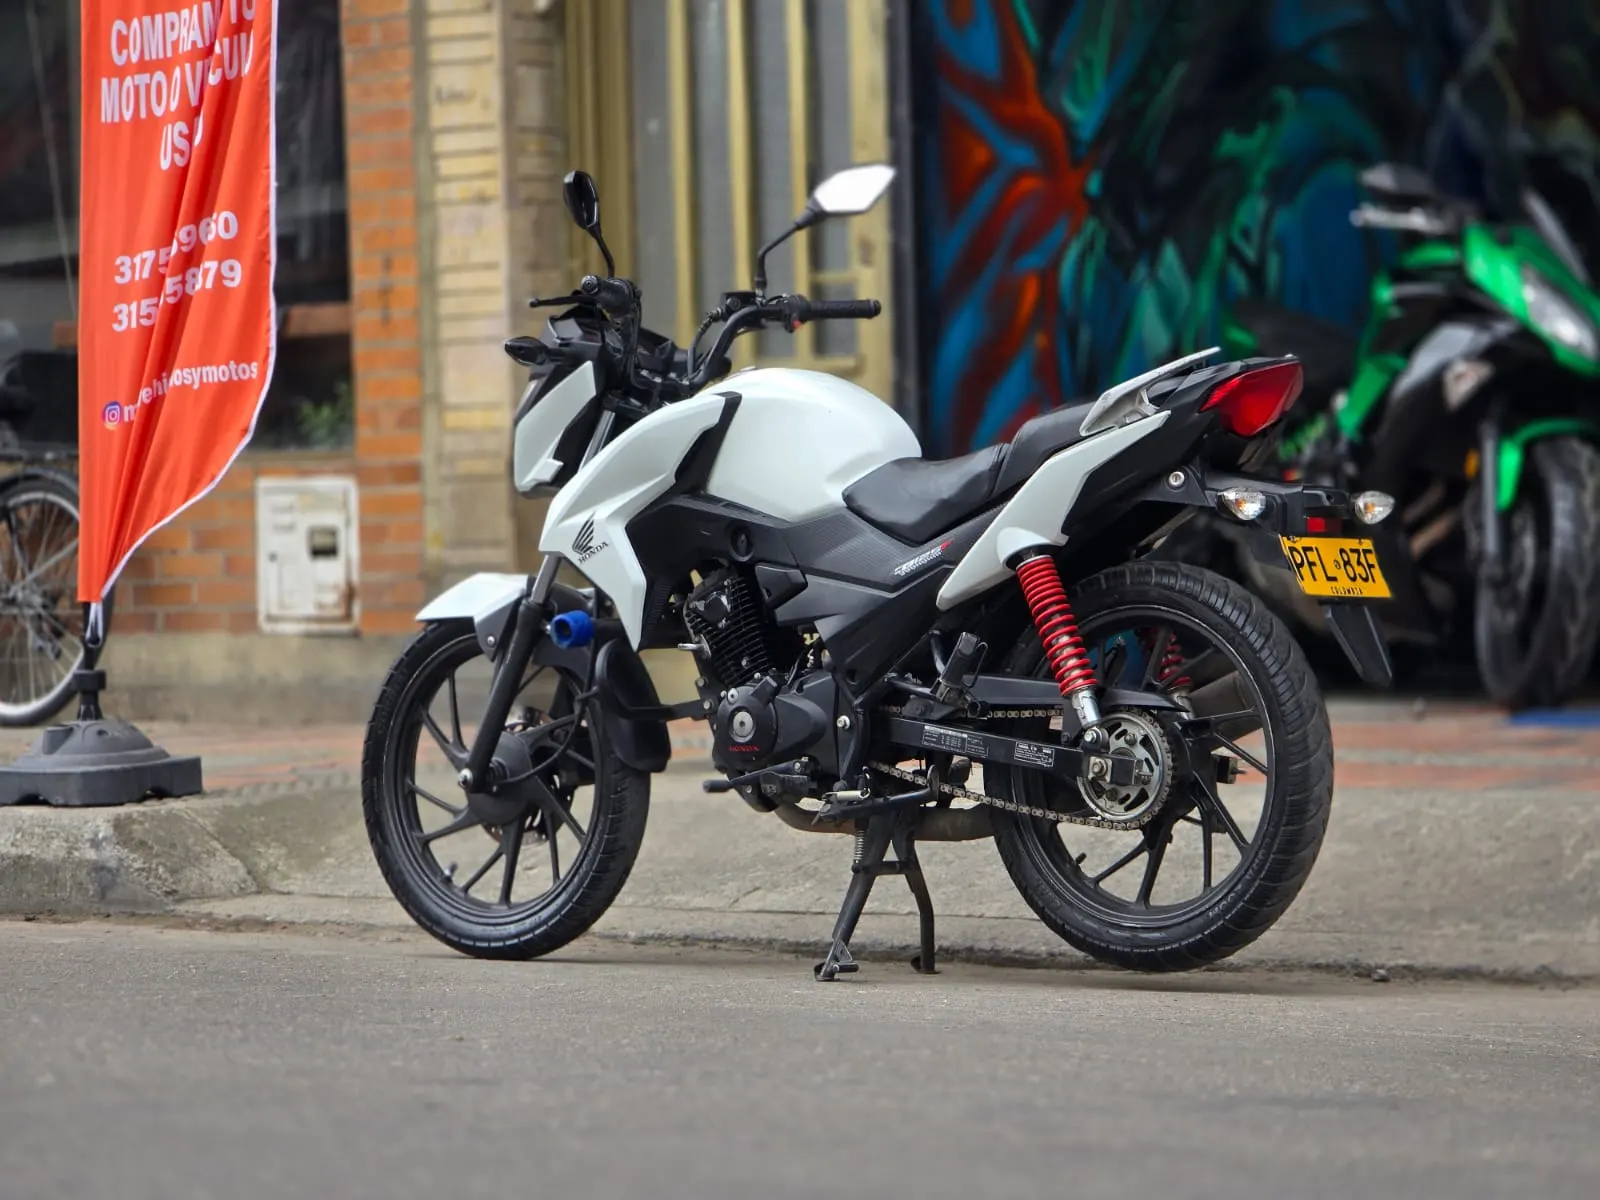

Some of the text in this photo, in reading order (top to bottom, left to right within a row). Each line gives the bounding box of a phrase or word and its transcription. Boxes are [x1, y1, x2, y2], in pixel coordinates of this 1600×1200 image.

[101, 71, 167, 123] MOTO
[578, 541, 609, 563] HONDA
[1288, 546, 1376, 583] PFL 83F
